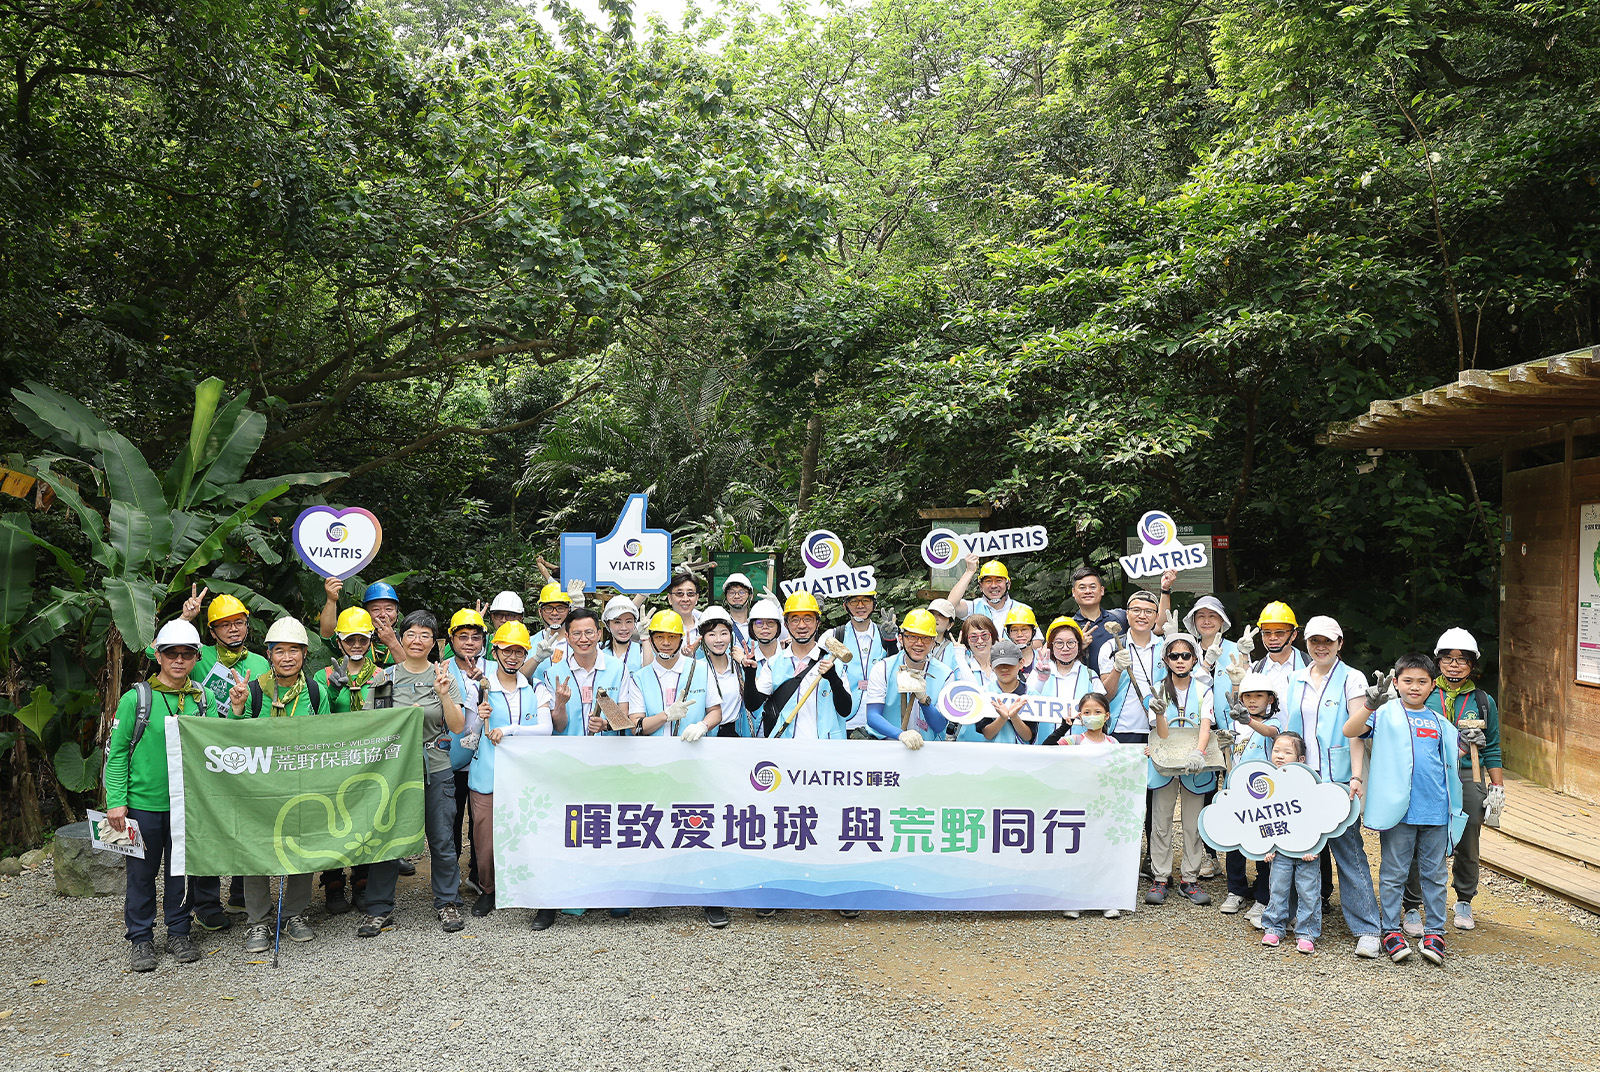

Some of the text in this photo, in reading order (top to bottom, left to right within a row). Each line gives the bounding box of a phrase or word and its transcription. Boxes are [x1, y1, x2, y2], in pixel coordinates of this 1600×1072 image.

[309, 546, 362, 559] VIATRIS
[963, 530, 1044, 553] VIATRIS
[609, 561, 656, 571] VIATRIS
[1125, 547, 1203, 574] VIATRIS
[991, 696, 1080, 720] ATRI
[293, 743, 331, 752] SOCIETY
[333, 741, 347, 749] OF
[348, 733, 401, 747] WILDERNESS
[203, 745, 274, 775] SOW
[274, 742, 403, 773] 荒野保護協會
[1234, 799, 1303, 825] VIATRIS
[564, 803, 1087, 854] 暉致愛地球 與荒野同行
[1258, 820, 1291, 839] 暉致
